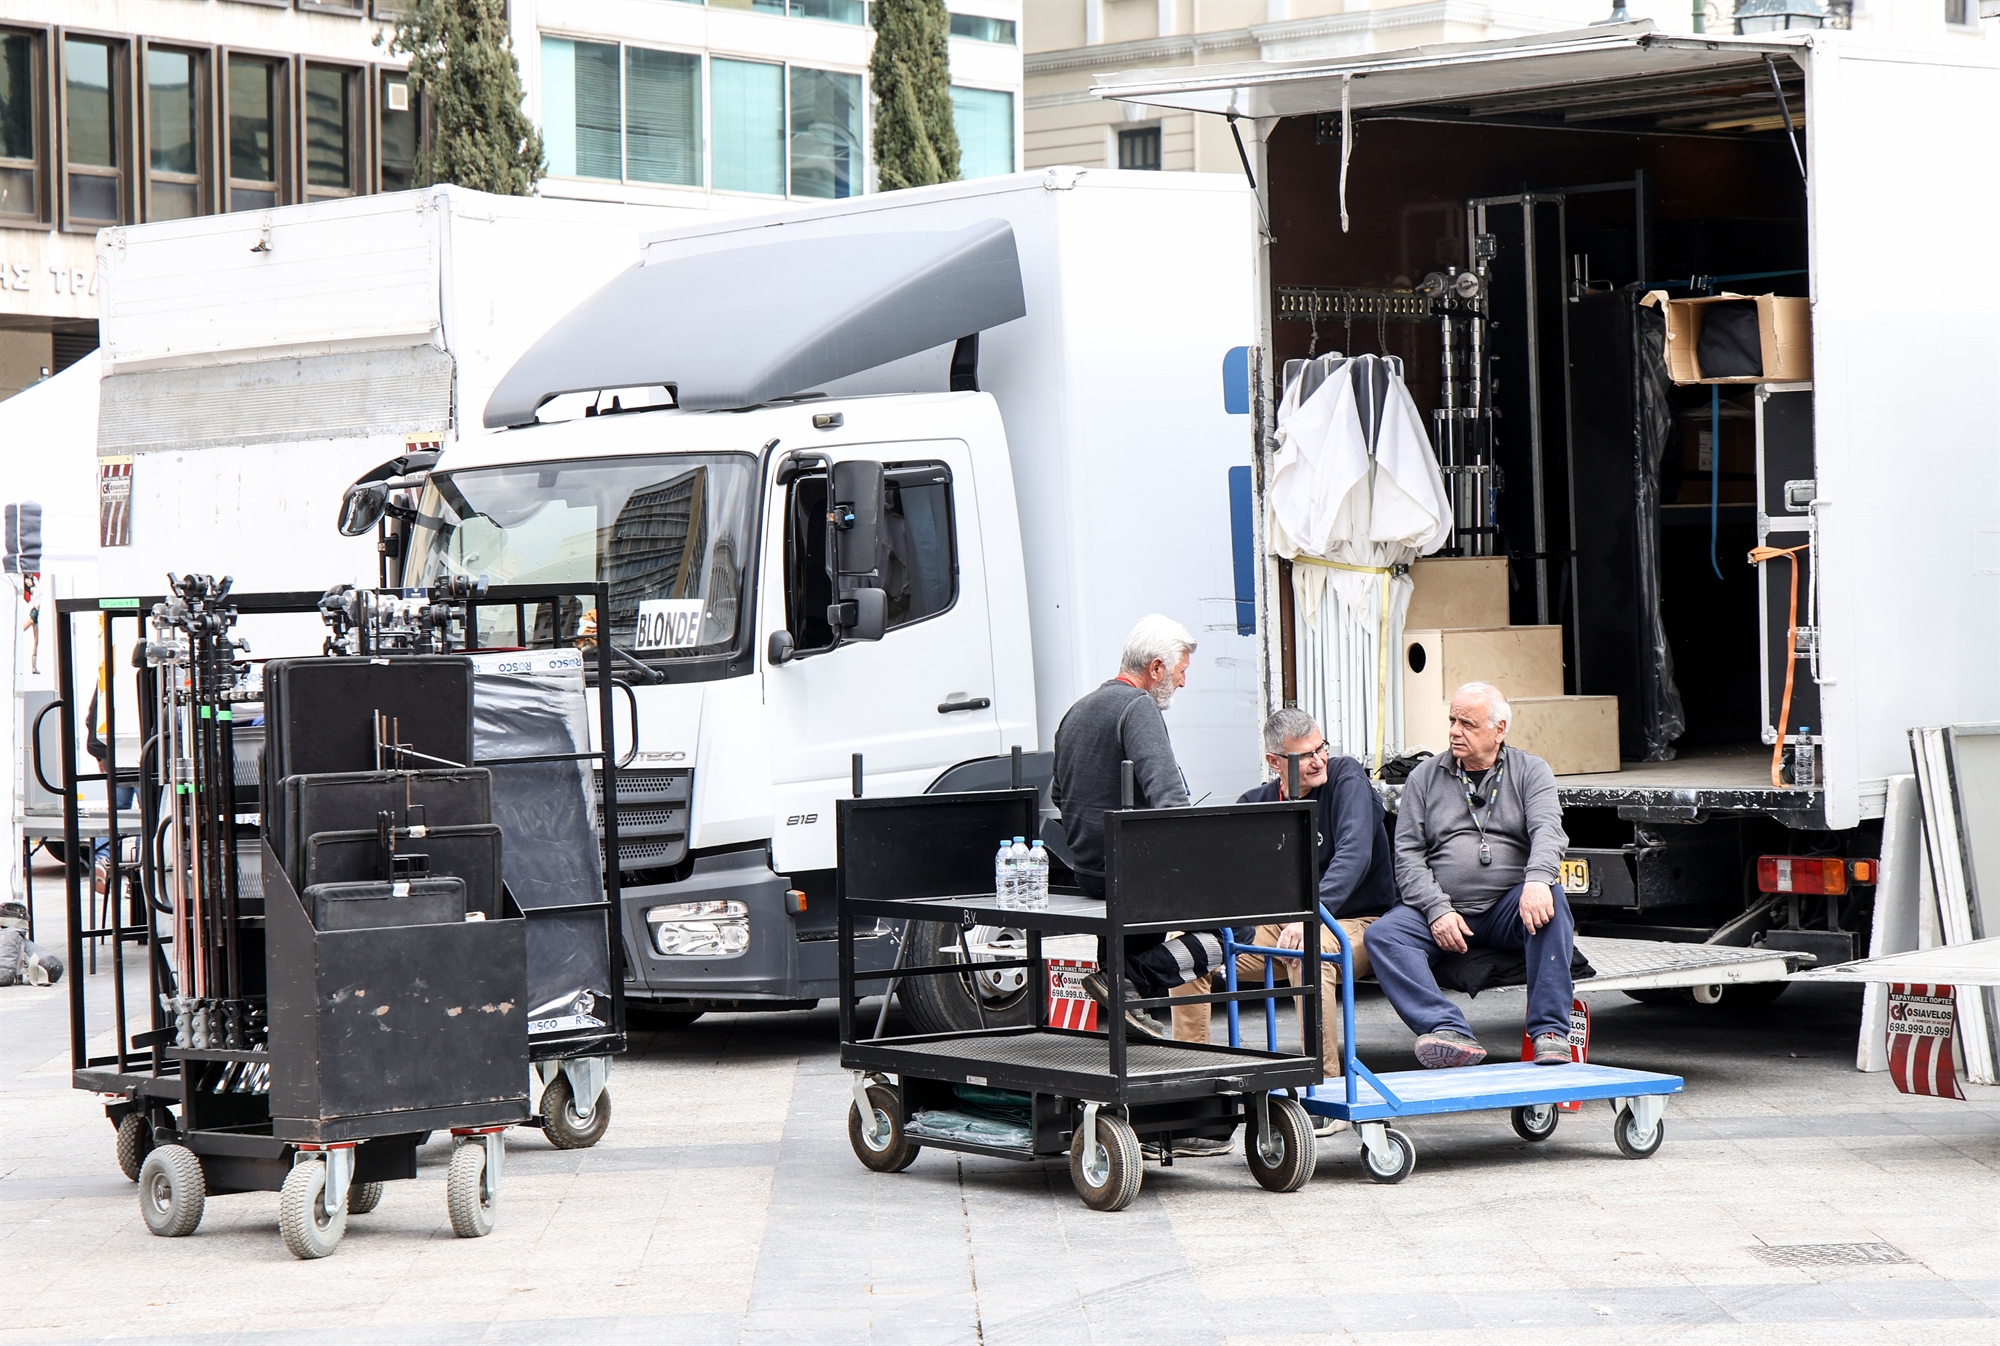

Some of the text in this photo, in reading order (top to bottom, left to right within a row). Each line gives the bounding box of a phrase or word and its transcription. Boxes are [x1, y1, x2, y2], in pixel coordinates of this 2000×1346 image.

[637, 611, 699, 648] BLONDE
[498, 658, 582, 672] ROSCO ROSCO
[786, 813, 818, 826] 818
[1052, 989, 1092, 1000] 698.999.0.99
[527, 1019, 558, 1034] OSCO
[1889, 1022, 1950, 1037] 698.999.0.999
